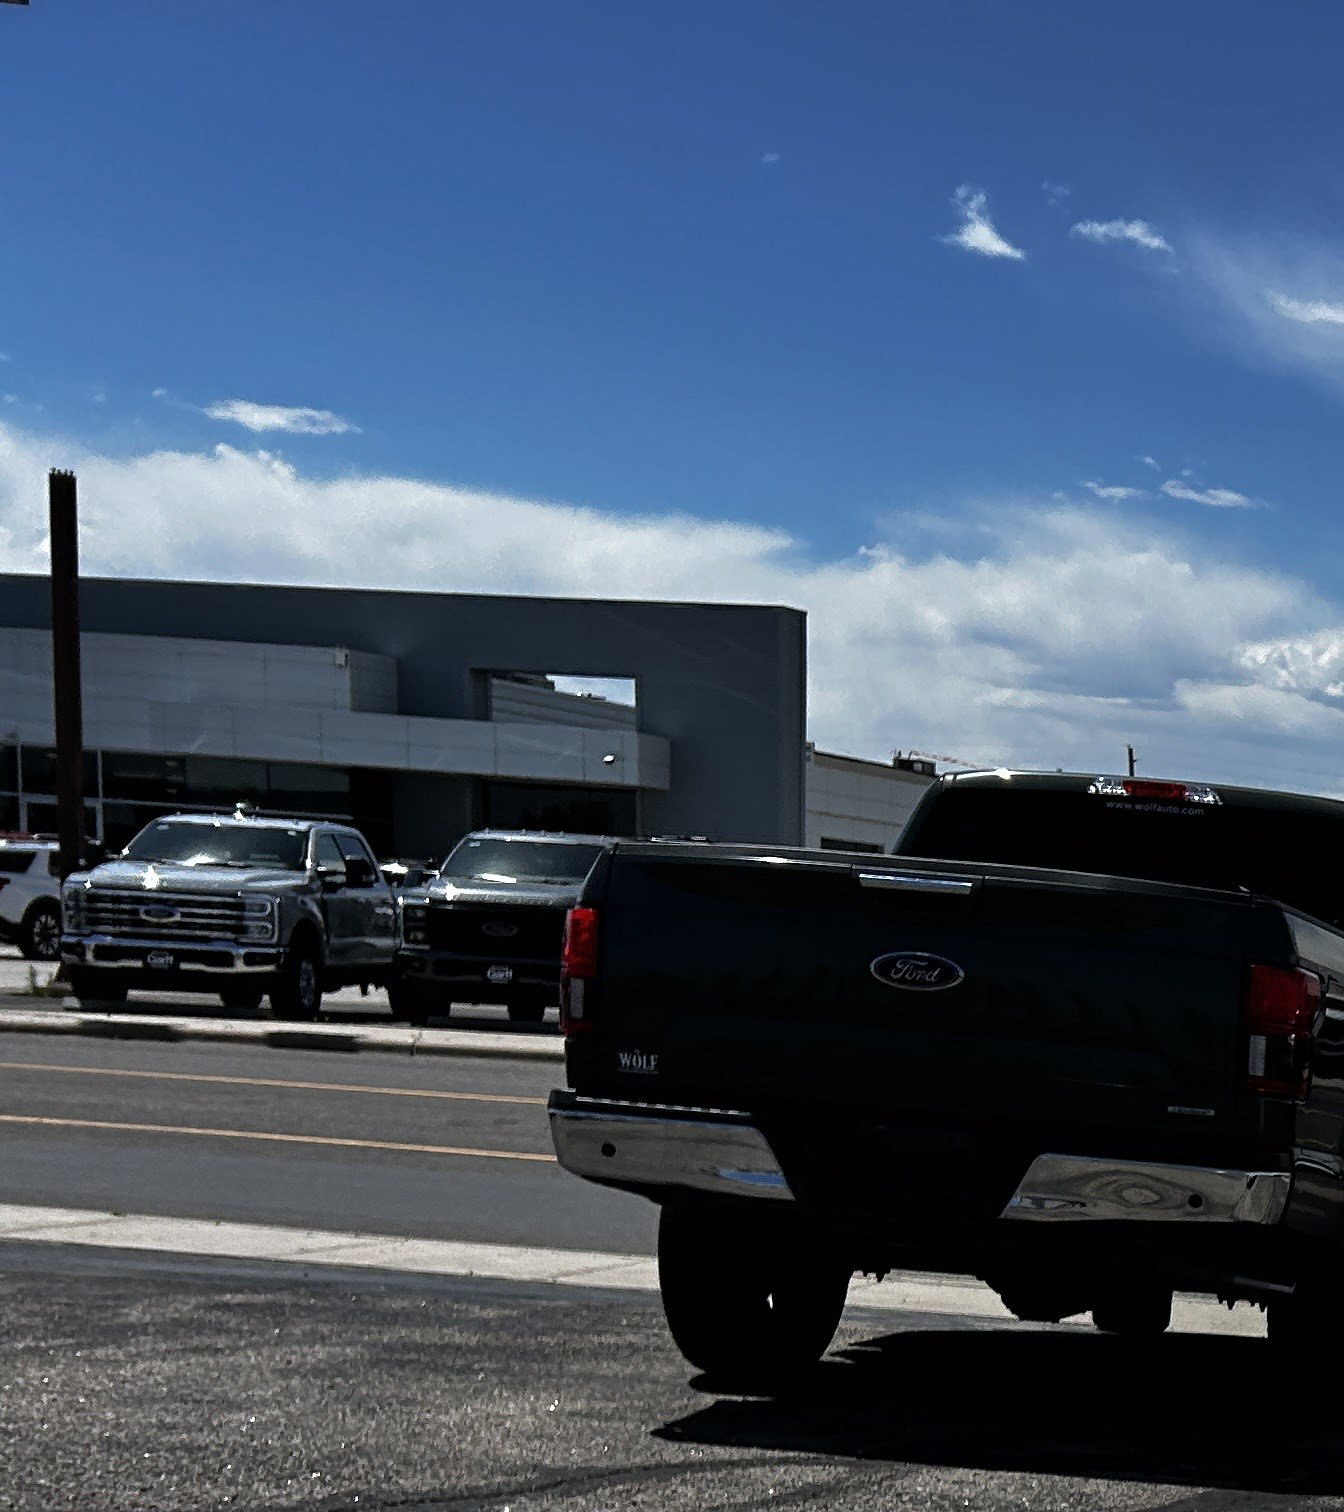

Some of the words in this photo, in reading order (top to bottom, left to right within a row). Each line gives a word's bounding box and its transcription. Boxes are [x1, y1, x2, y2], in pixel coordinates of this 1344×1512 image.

[1105, 801, 1205, 816] www.wolfauto.com
[890, 959, 941, 982] Ford
[619, 1051, 659, 1071] WOLF
